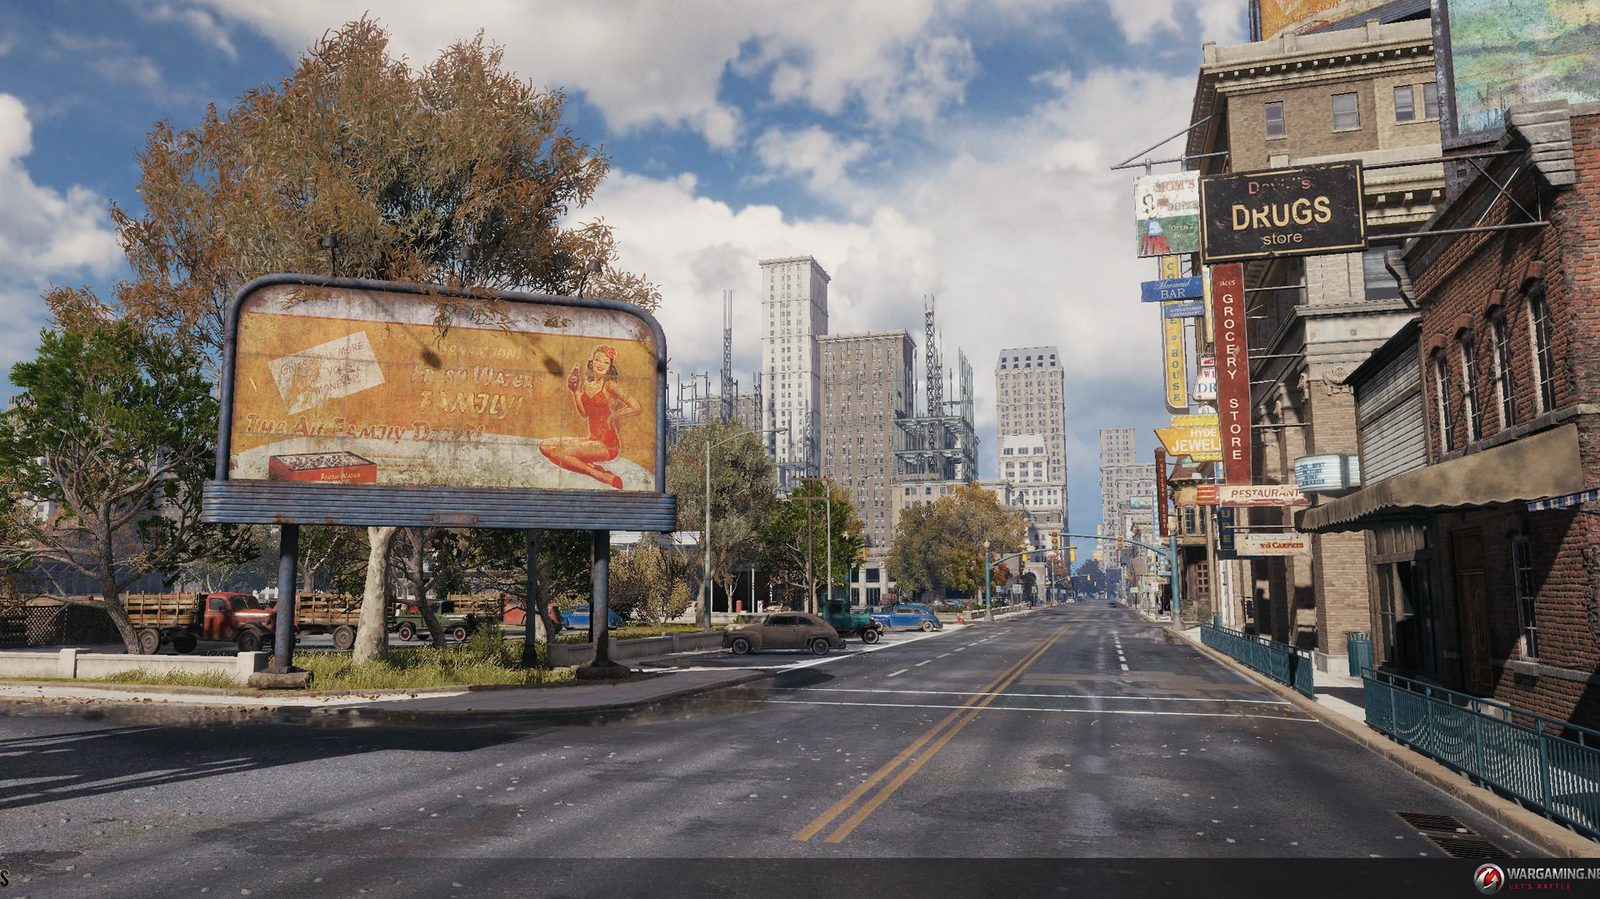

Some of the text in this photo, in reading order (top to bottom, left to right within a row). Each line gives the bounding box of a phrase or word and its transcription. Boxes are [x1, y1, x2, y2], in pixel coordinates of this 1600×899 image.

[1231, 195, 1333, 231] DRUGS
[1262, 232, 1304, 246] store
[1160, 287, 1187, 300] BAR
[338, 341, 364, 358] MORE
[1171, 348, 1182, 402] HOUSE
[1222, 293, 1242, 460] GROCERY STORE
[1190, 428, 1217, 438] HYDE
[1230, 487, 1300, 499] RESTAURANT
